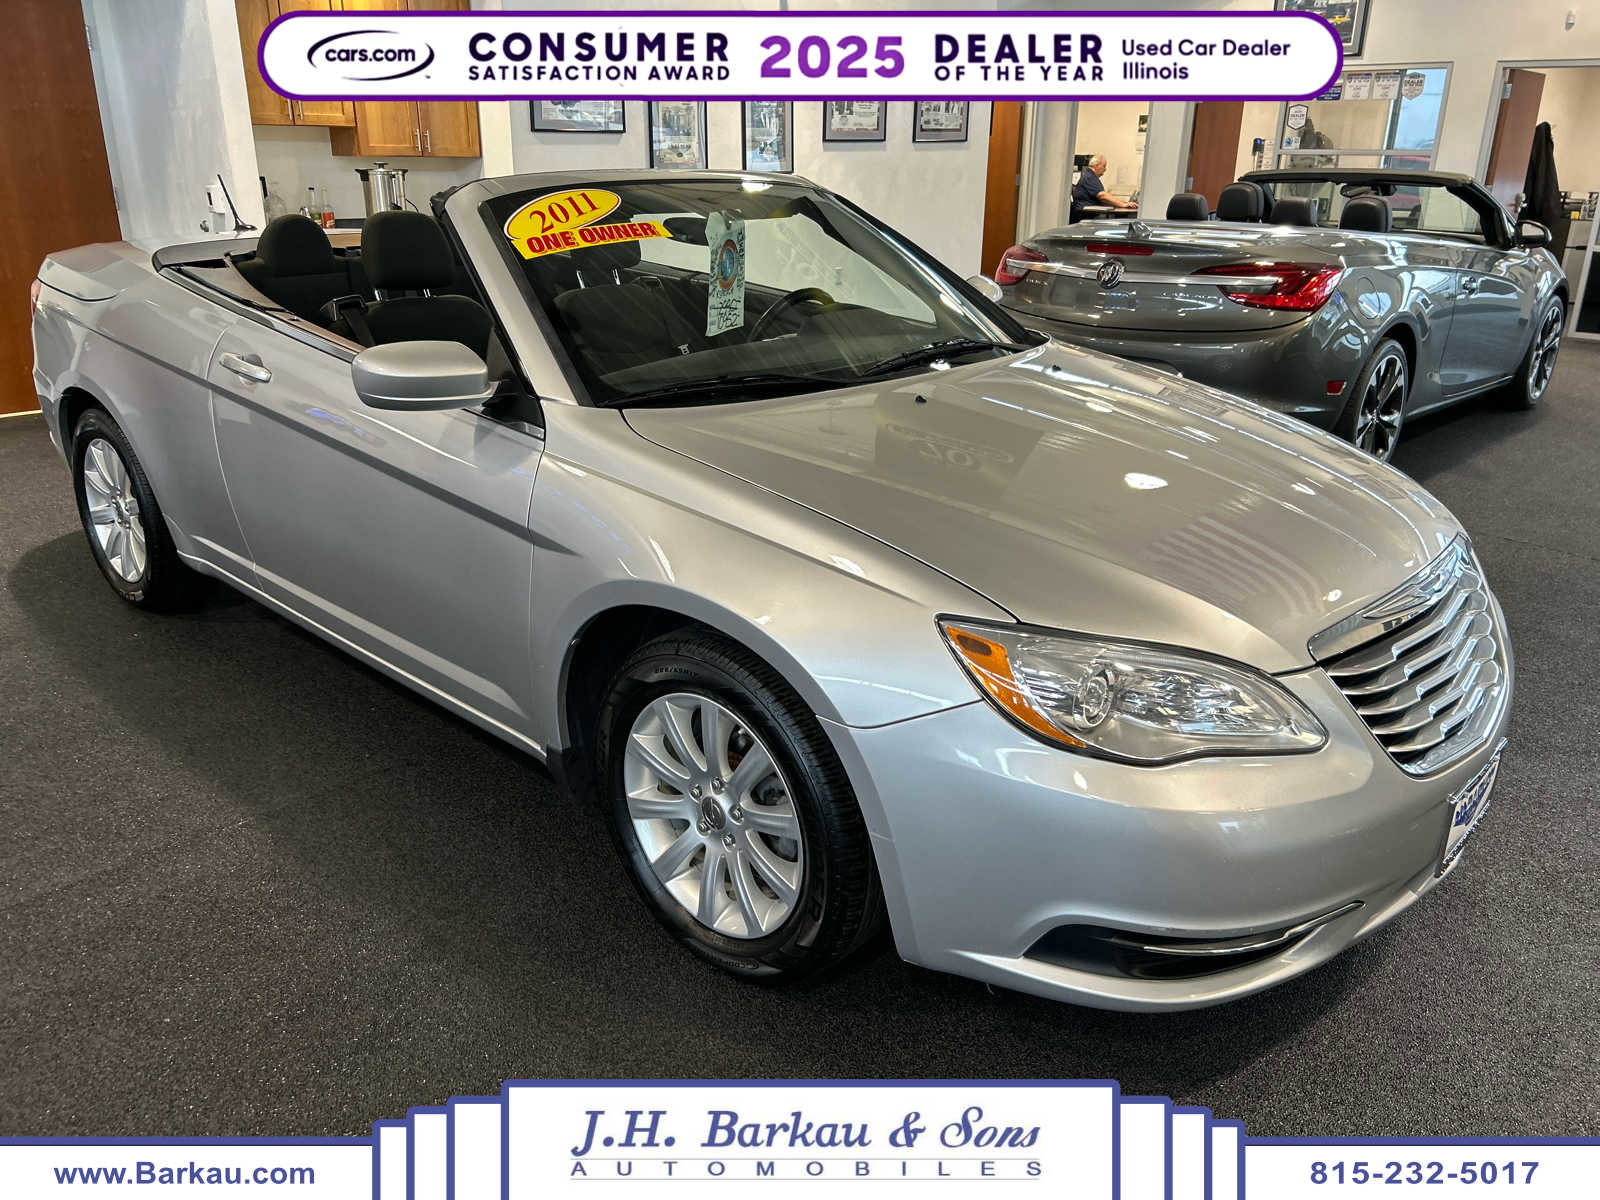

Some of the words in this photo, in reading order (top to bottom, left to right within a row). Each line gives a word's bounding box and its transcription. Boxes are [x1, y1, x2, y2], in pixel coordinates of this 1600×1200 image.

[529, 192, 600, 233] 2011
[526, 230, 580, 254] ONE
[578, 222, 659, 244] OWNER
